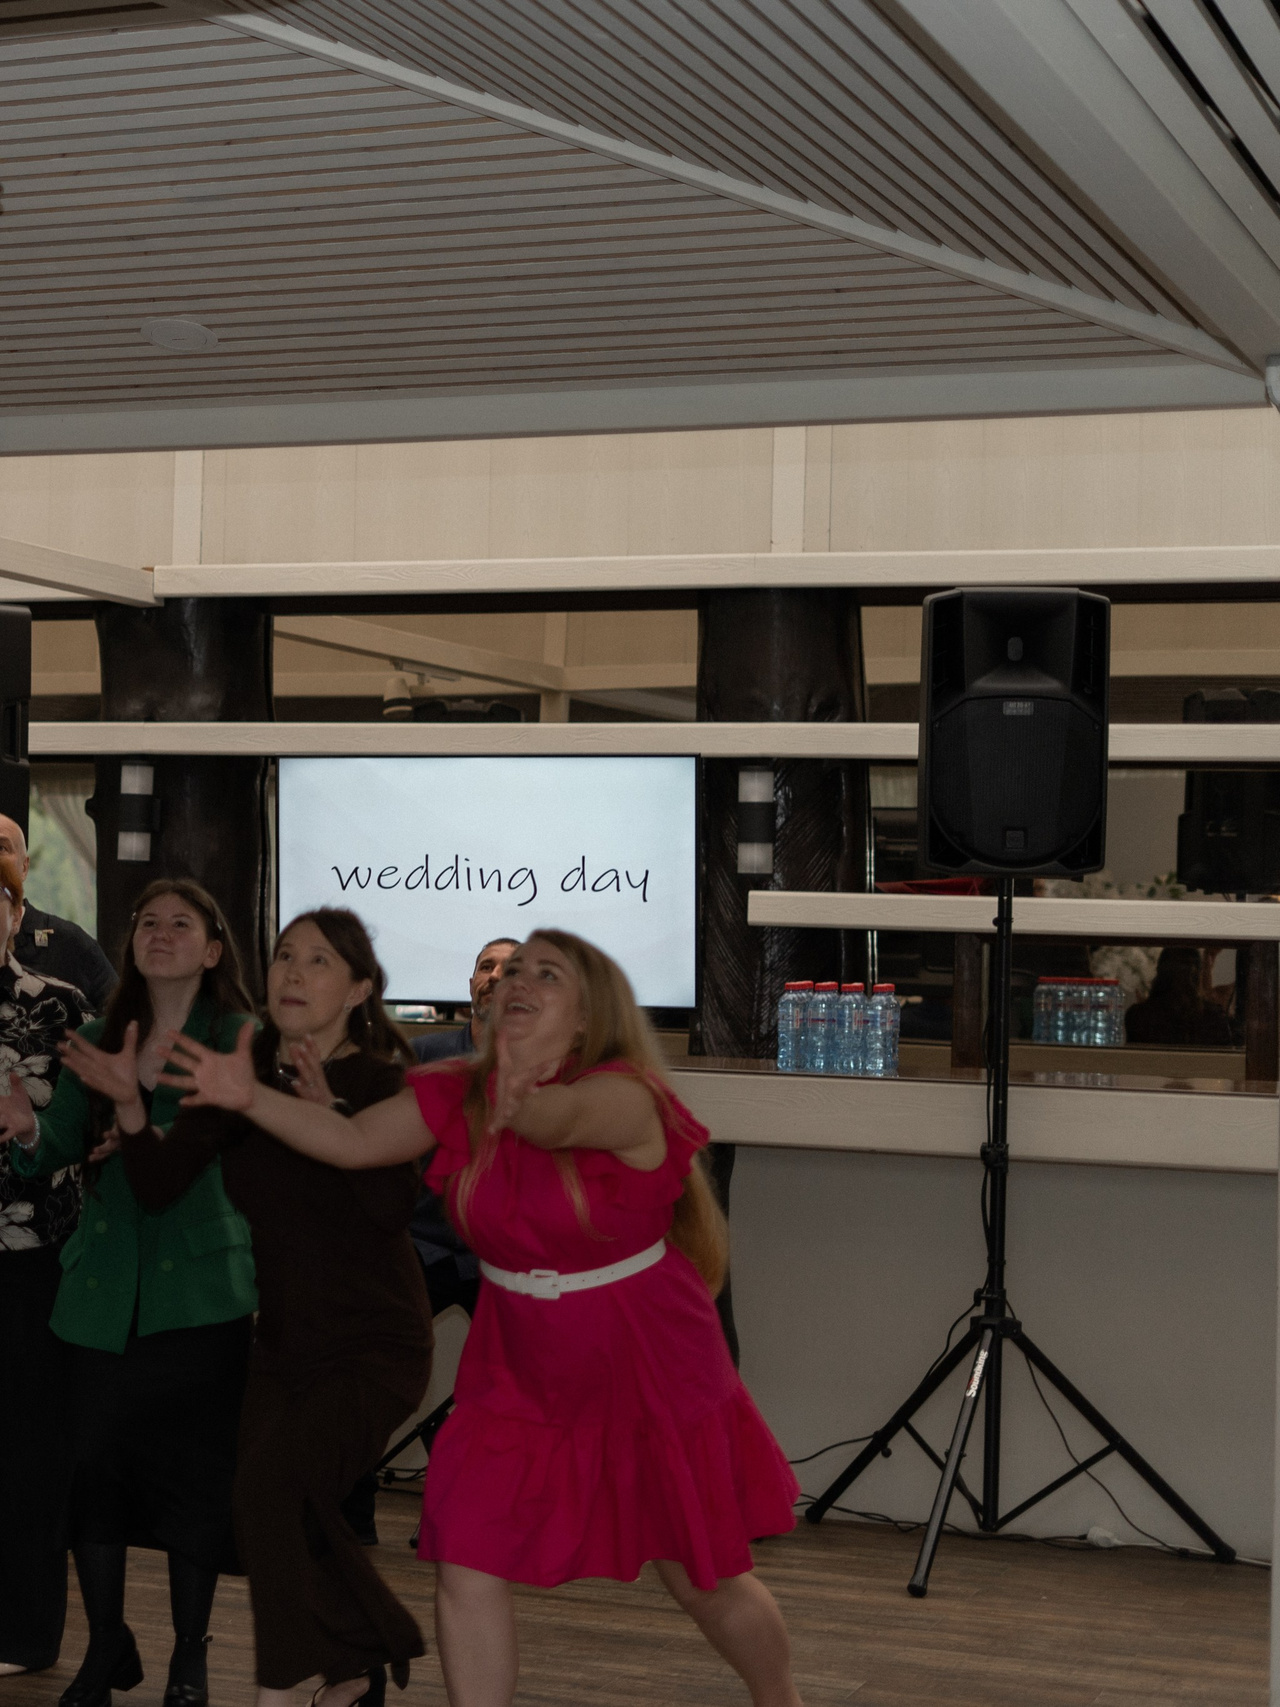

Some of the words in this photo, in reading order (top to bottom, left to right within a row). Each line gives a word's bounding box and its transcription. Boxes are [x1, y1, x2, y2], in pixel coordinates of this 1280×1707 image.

[331, 854, 538, 907] wedding
[560, 855, 650, 903] day
[965, 1349, 988, 1398] Soundking
